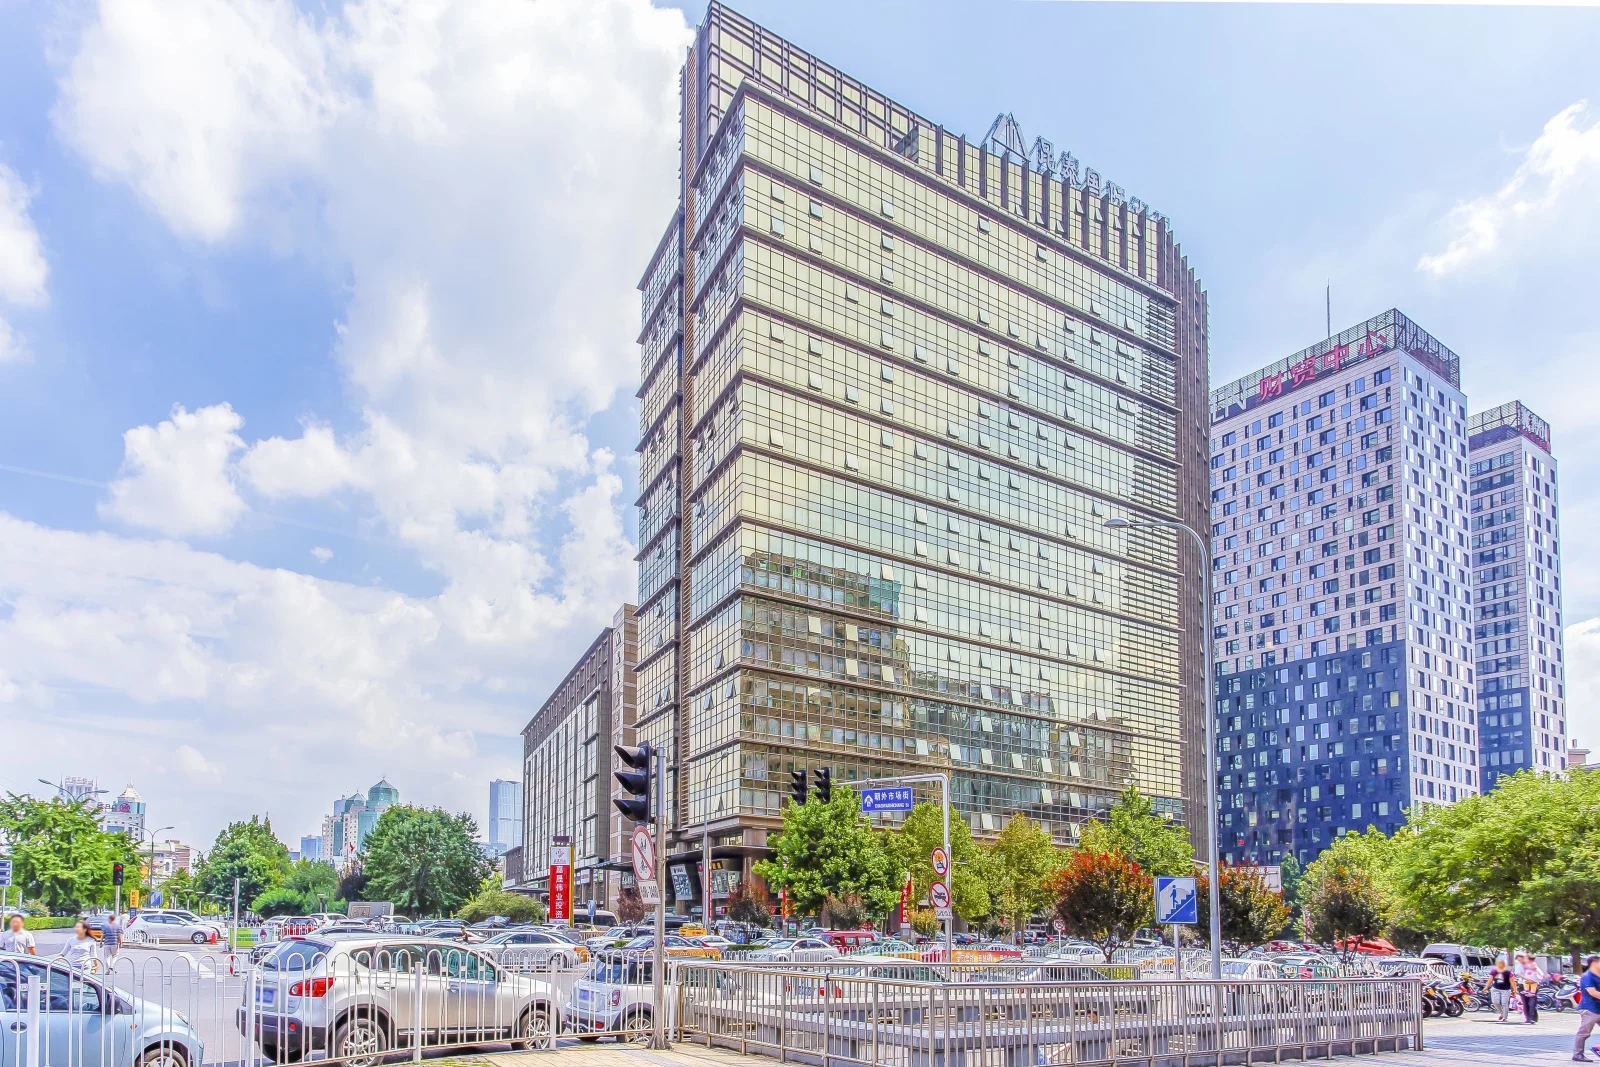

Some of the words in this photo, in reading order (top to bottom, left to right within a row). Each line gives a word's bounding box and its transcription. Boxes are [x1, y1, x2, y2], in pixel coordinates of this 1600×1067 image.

[1259, 330, 1386, 401] 财贸中心
[874, 790, 909, 801] 朝外市场街
